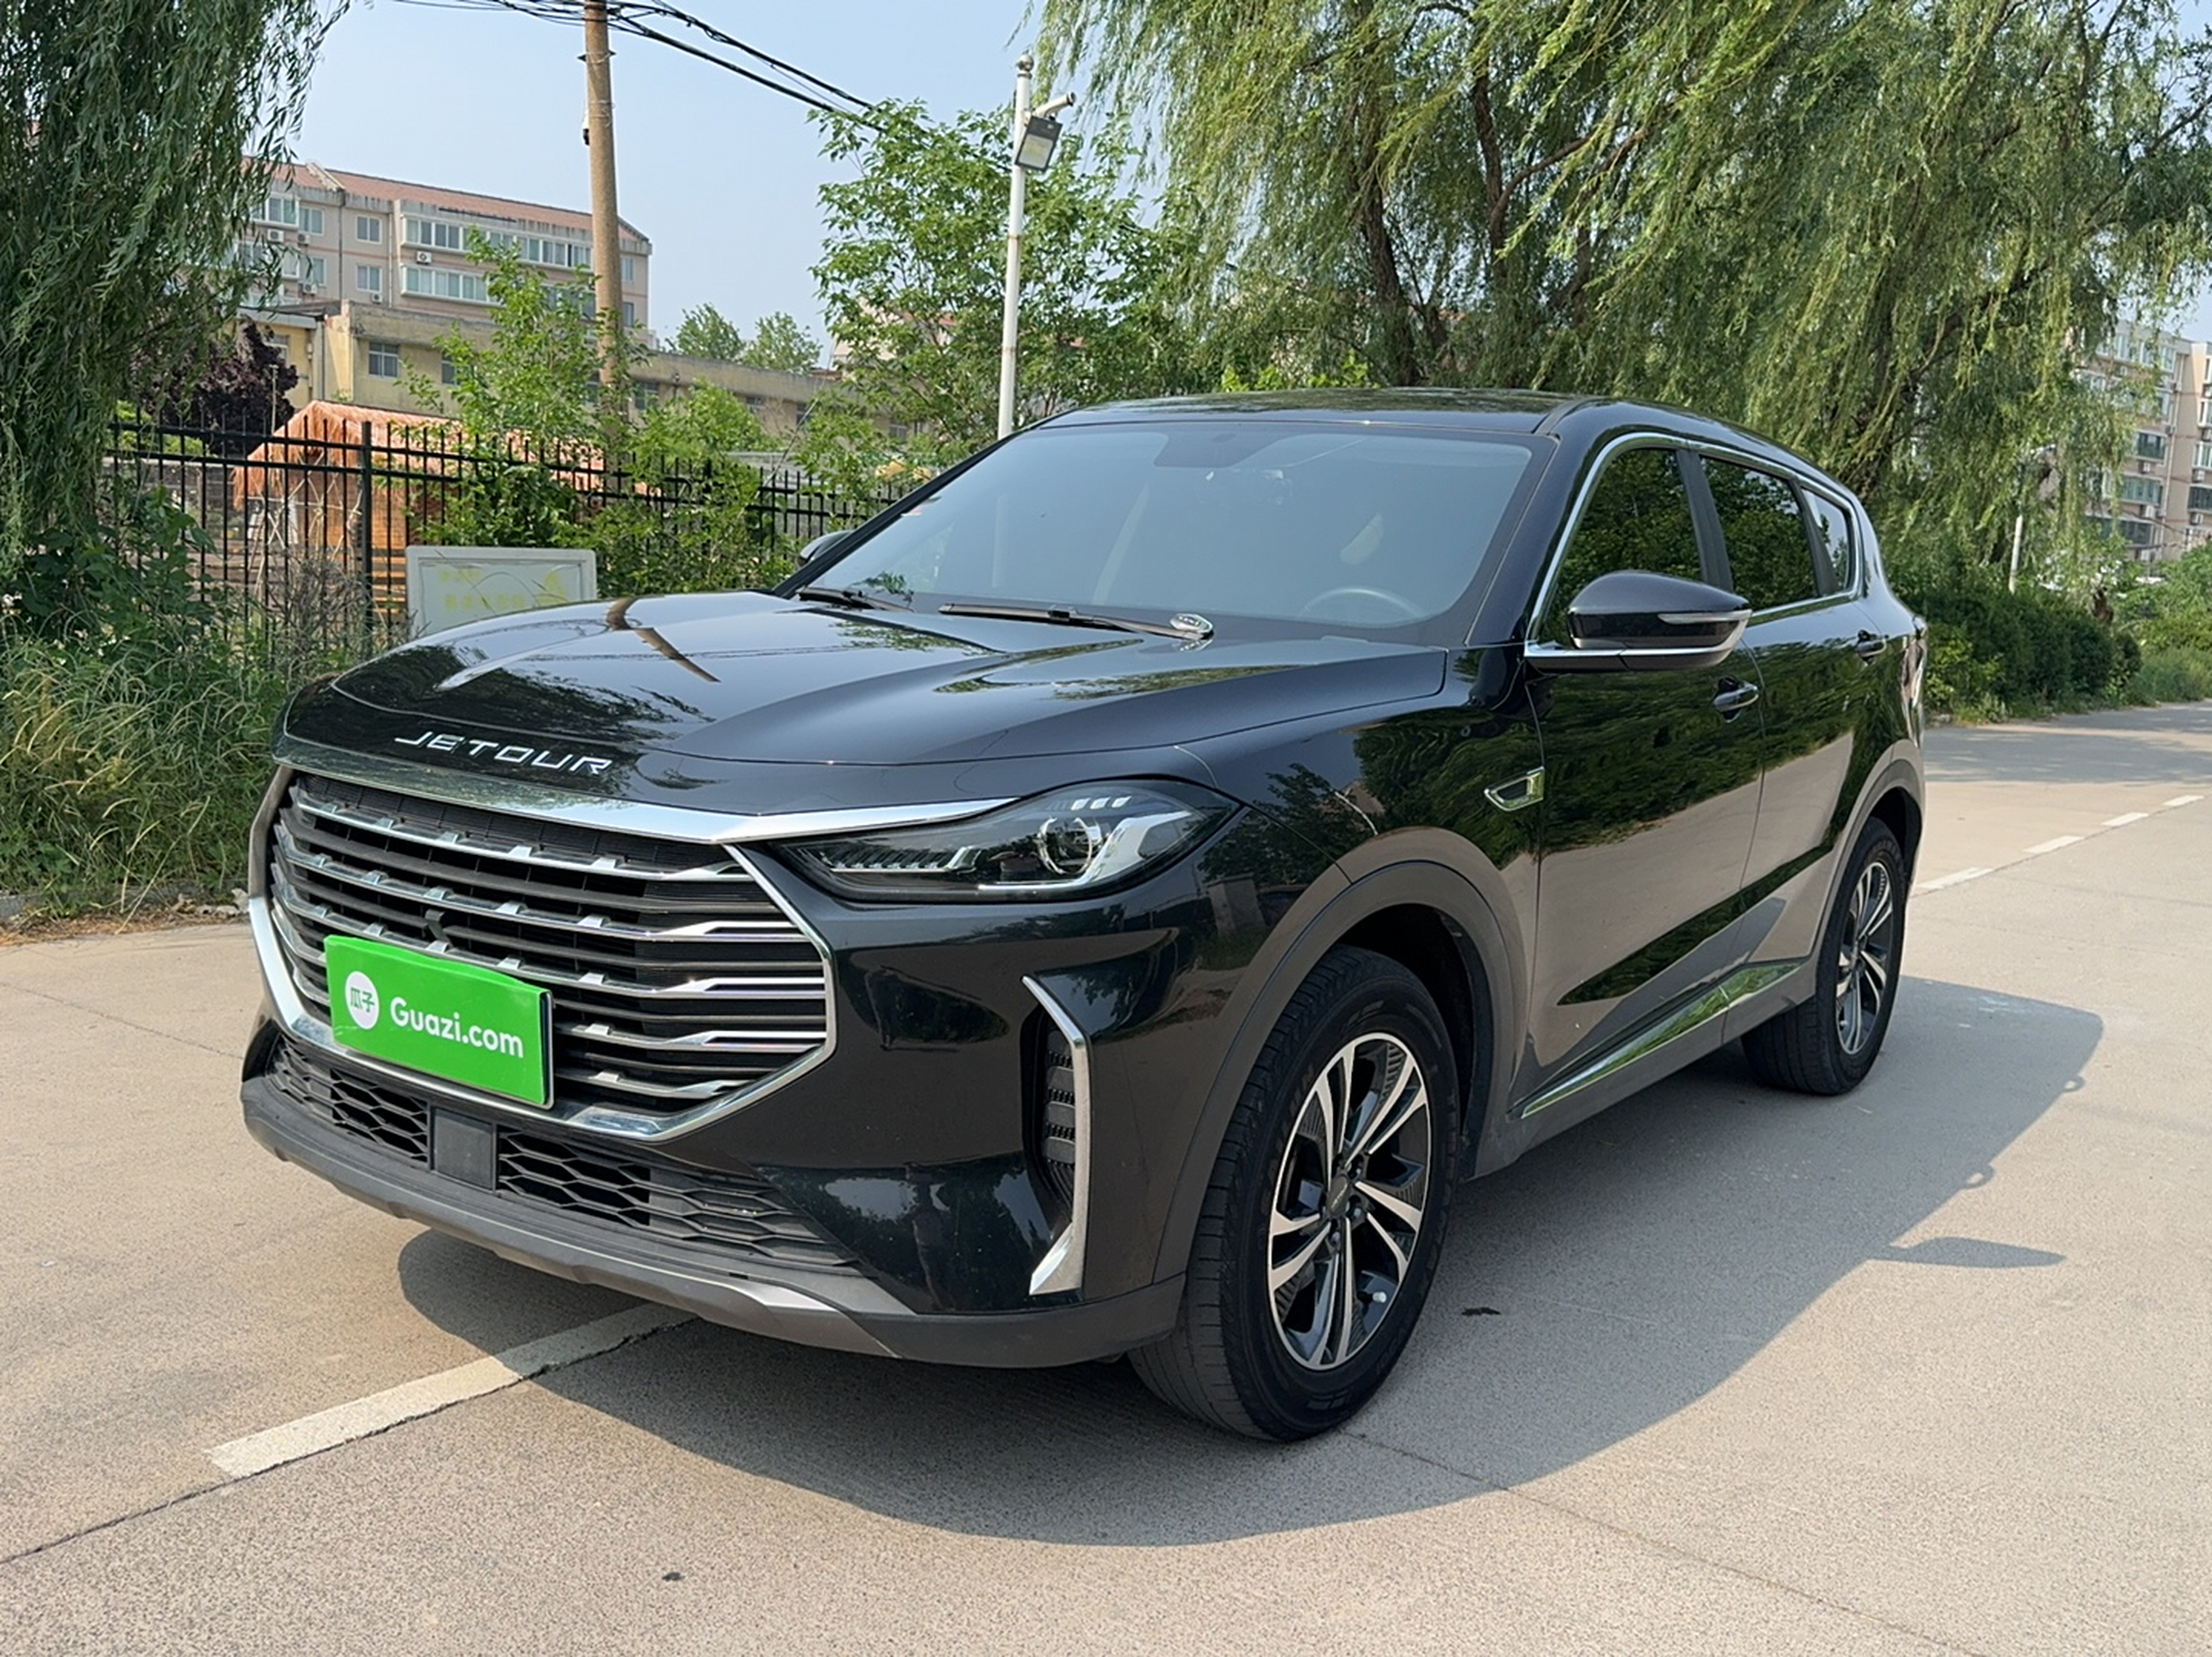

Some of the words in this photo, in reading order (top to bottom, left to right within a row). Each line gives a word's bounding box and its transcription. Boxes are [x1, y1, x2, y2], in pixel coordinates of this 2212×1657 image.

[395, 731, 613, 774] JETOUR
[350, 987, 374, 1013] 瓜子
[391, 997, 524, 1058] Guazi.com
